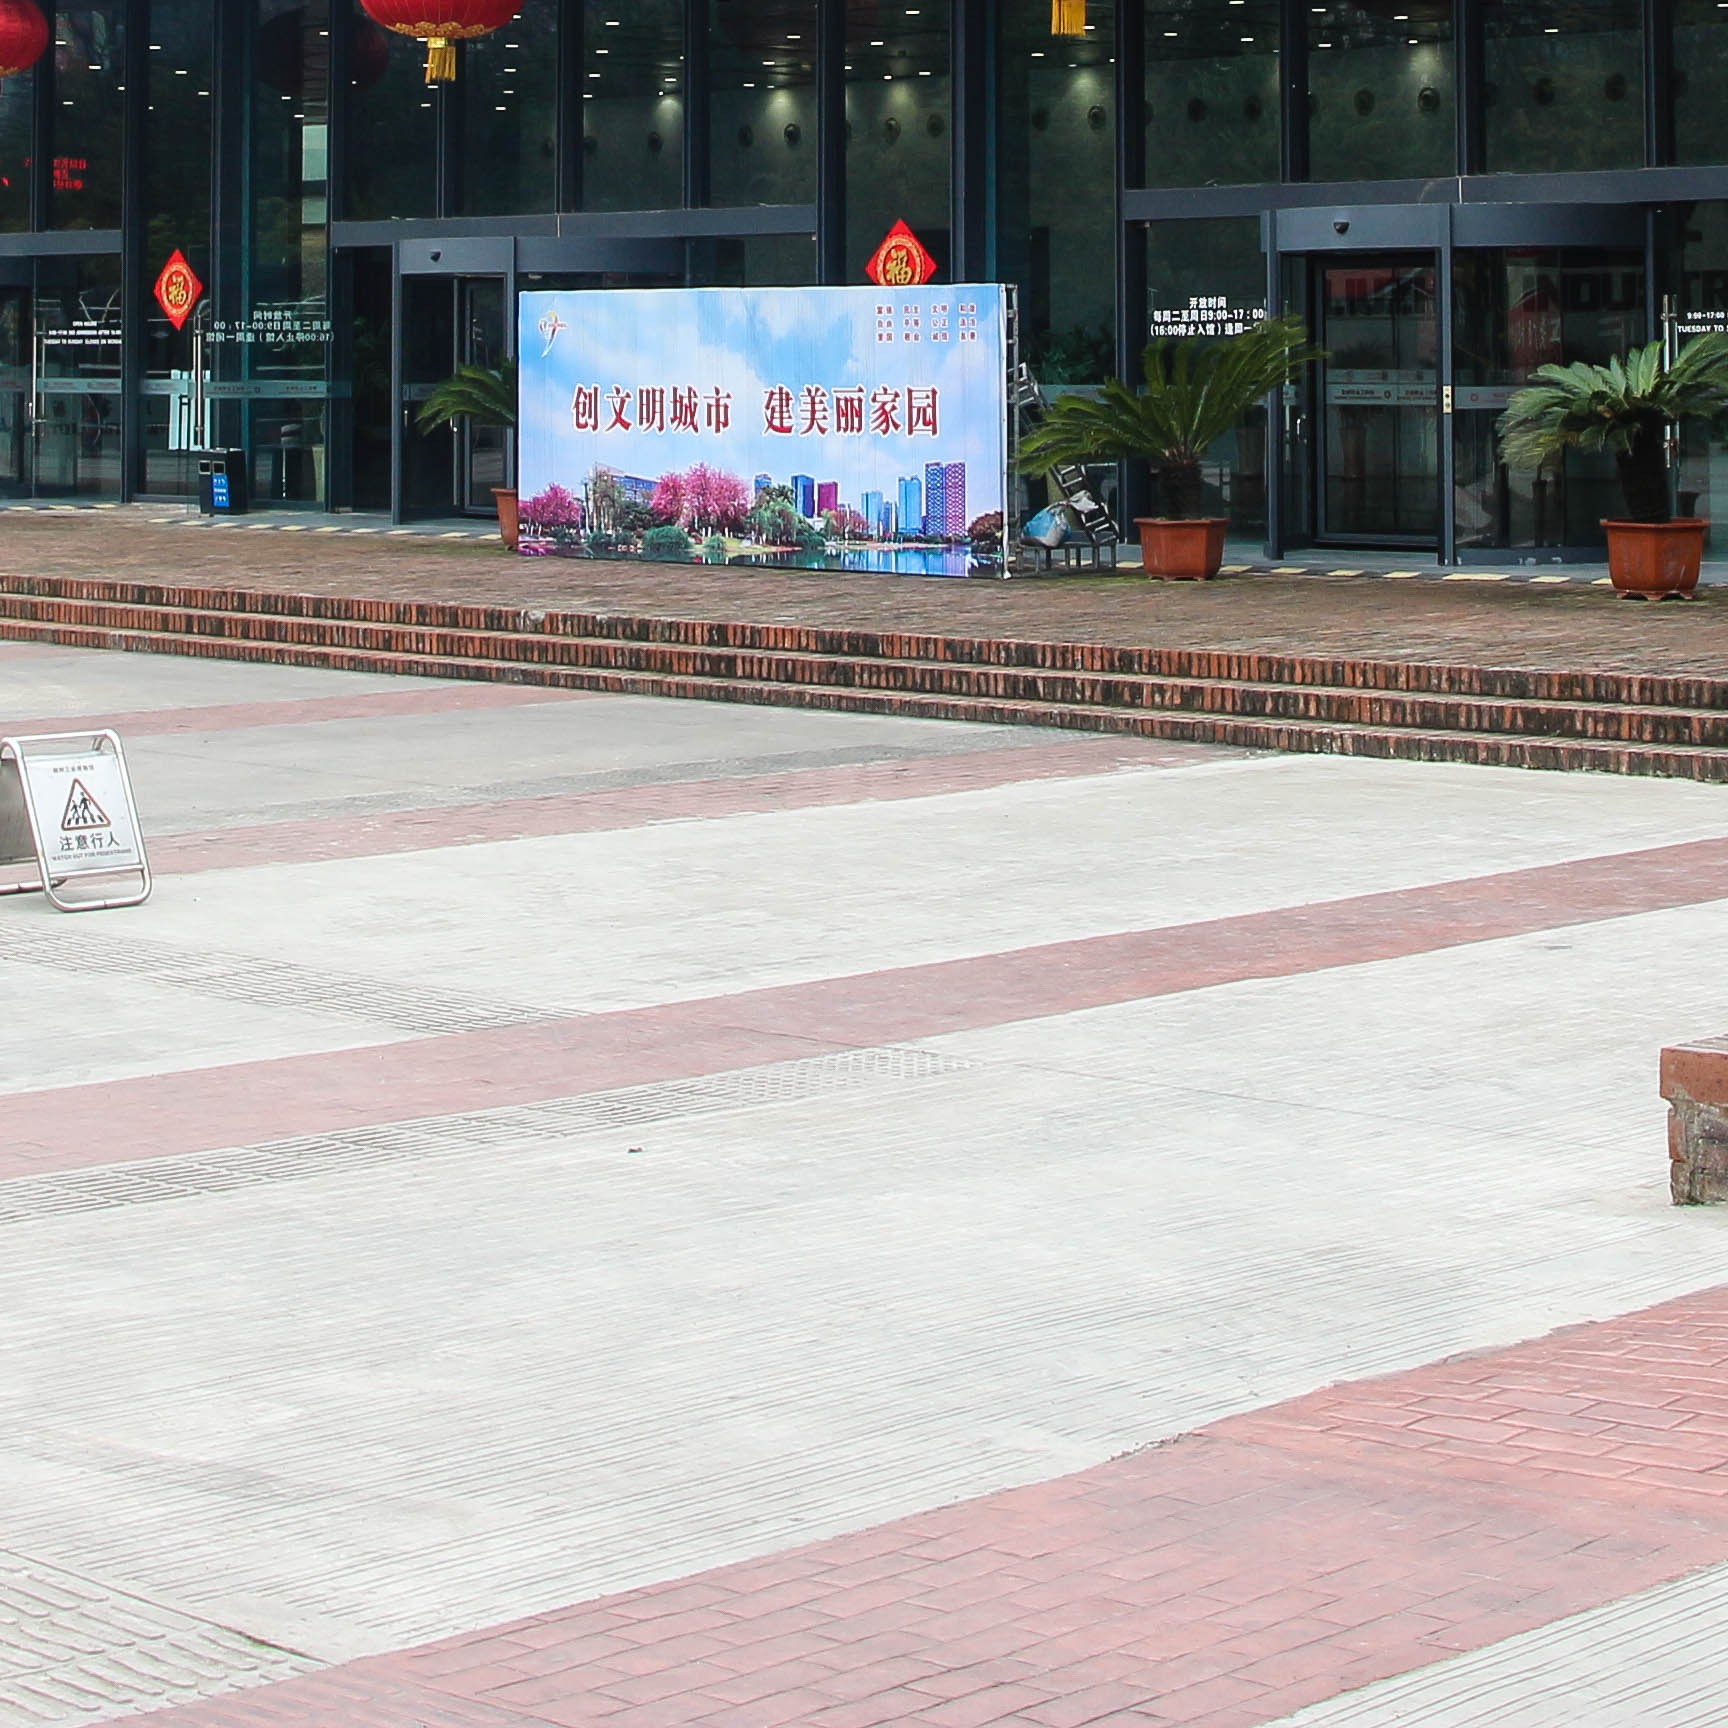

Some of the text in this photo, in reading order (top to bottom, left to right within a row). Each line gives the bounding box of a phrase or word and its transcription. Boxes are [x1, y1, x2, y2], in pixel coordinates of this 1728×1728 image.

[1189, 296, 1227, 309] 开放时间
[1677, 324, 1711, 333] TUESDAY
[1714, 324, 1724, 333] TO
[571, 383, 941, 436] 创文明城市 建美丽家园
[59, 831, 120, 851] 注意行人
